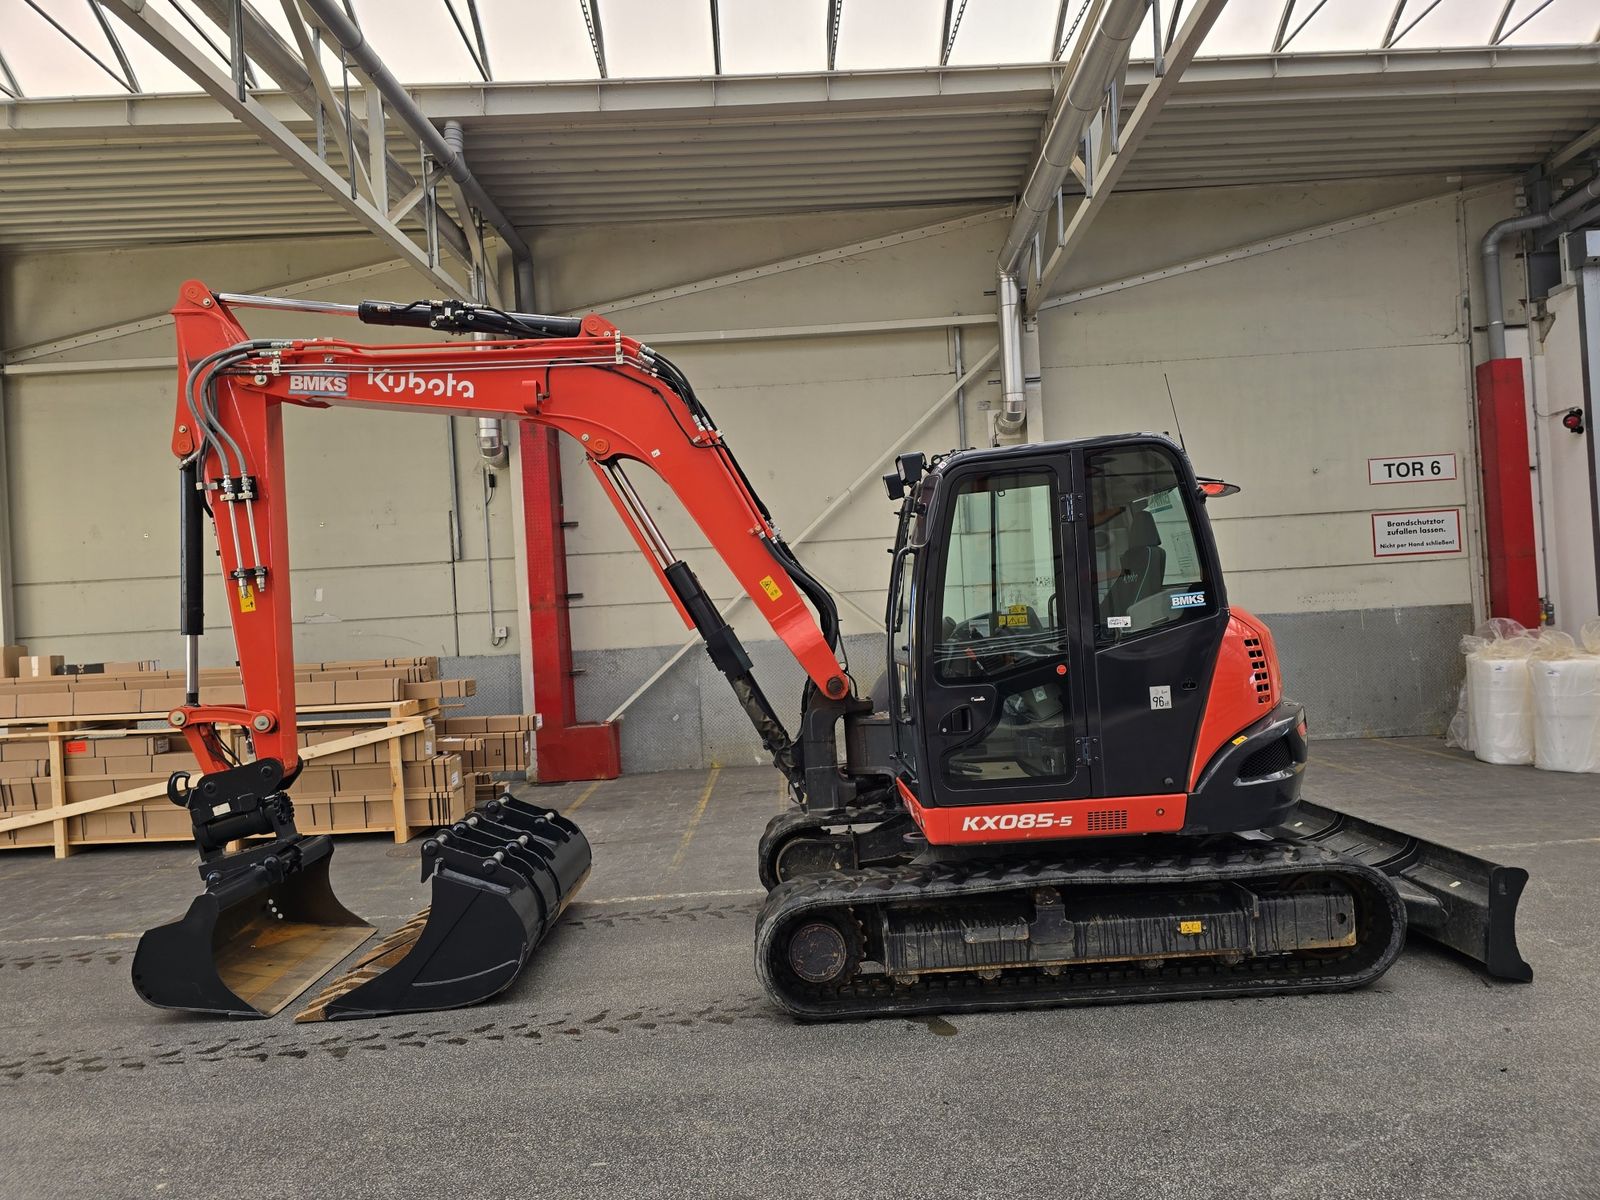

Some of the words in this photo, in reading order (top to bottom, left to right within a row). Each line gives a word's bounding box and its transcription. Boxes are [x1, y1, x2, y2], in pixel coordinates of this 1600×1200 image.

[289, 375, 347, 392] BMKS
[367, 367, 475, 398] Kubota
[1383, 461, 1424, 478] TOR
[1430, 460, 1441, 475] 6
[1387, 518, 1445, 528] Brandschutztor
[1387, 528, 1418, 536] zufallen
[1171, 594, 1205, 607] BMKS
[1152, 695, 1165, 708] 96
[962, 813, 1073, 831] KX085-5
